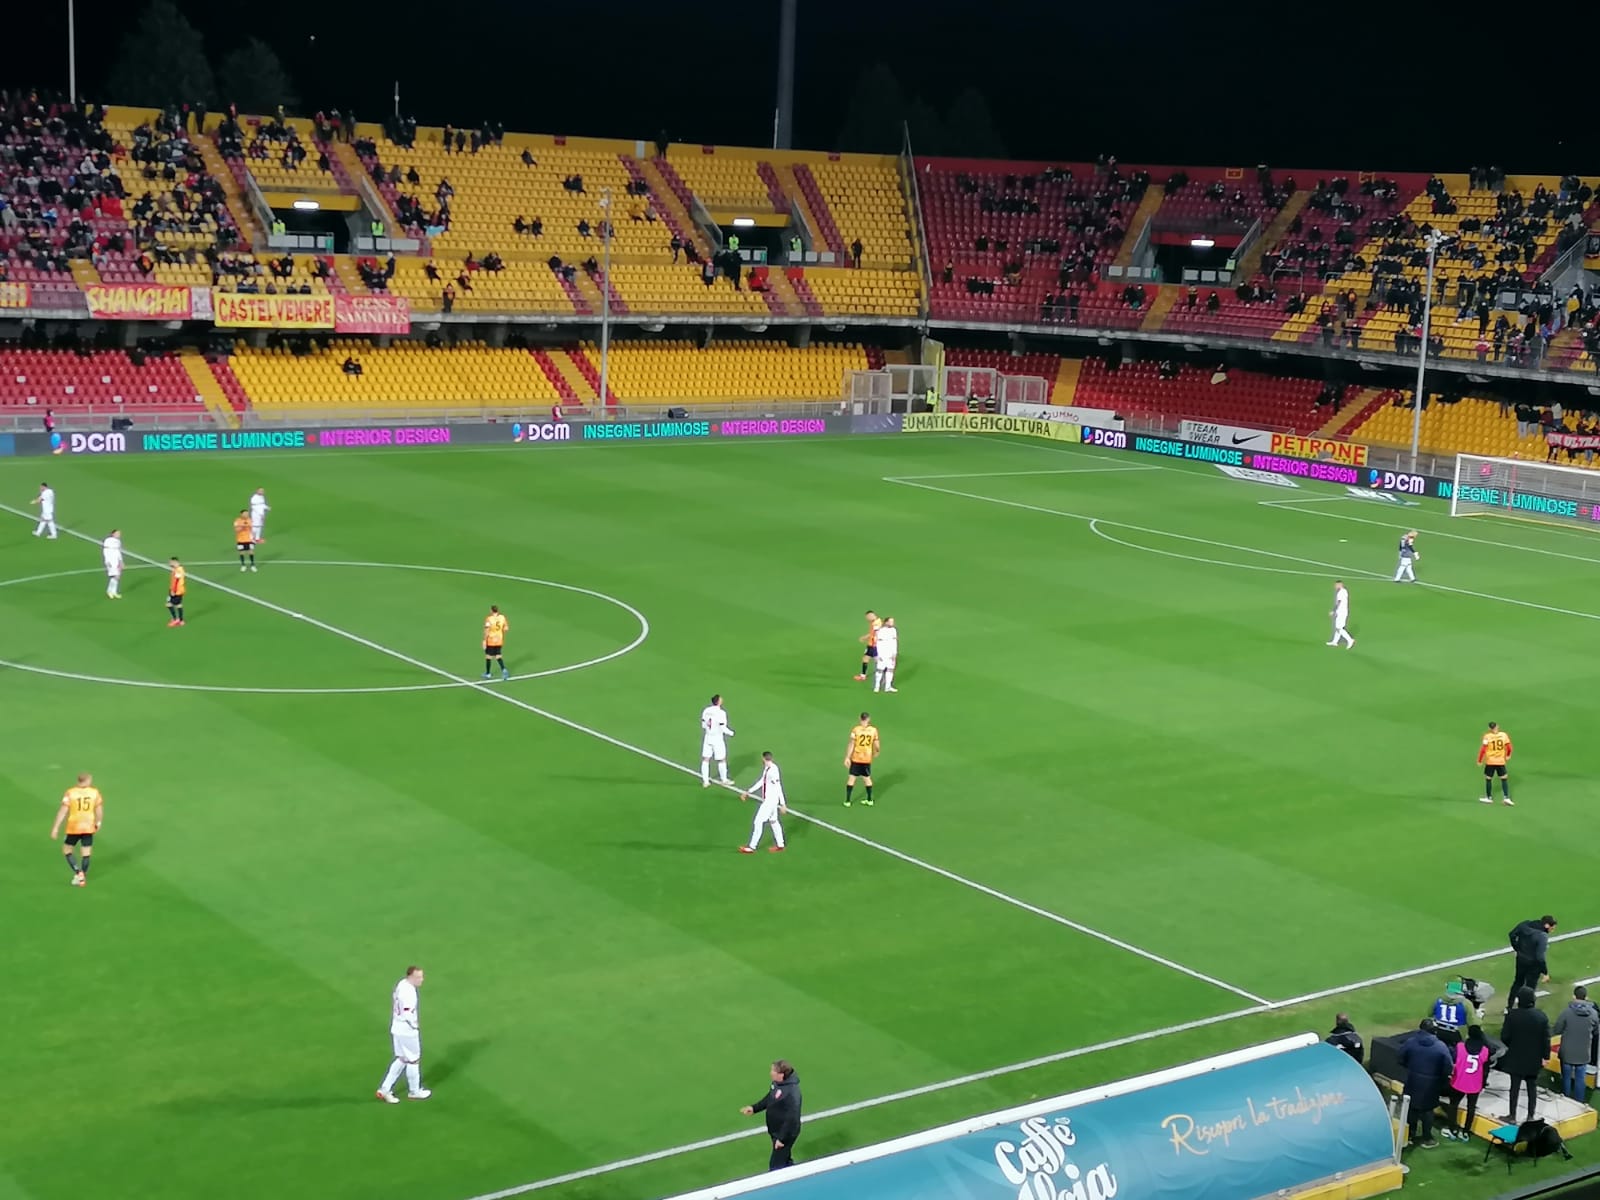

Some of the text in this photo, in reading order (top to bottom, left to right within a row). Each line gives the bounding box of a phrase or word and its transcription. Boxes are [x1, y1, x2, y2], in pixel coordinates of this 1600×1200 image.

[528, 418, 825, 441] DCM INSEGNE LUMINOSE INTERIOR DESIGN
[960, 416, 1051, 437] AGRICOLTURA
[71, 427, 450, 452] DCM INSEGNE LUMINOSE INTERIOR DESIGN
[1271, 433, 1366, 466] PETRONE
[1094, 429, 1127, 448] DCM
[1135, 436, 1183, 455] INSEGNE
[1184, 442, 1243, 466] LUMINOSE
[1252, 454, 1308, 477] INTERIOR
[1310, 463, 1358, 484] DESIGN
[1384, 472, 1425, 494] DCM
[1502, 490, 1578, 517] LUMINOSE
[858, 734, 872, 748] 23
[1491, 739, 1504, 751] 19
[77, 796, 90, 812] 15
[1439, 1004, 1458, 1024] 11
[1465, 1054, 1479, 1074] 5
[1246, 1096, 1270, 1127] la
